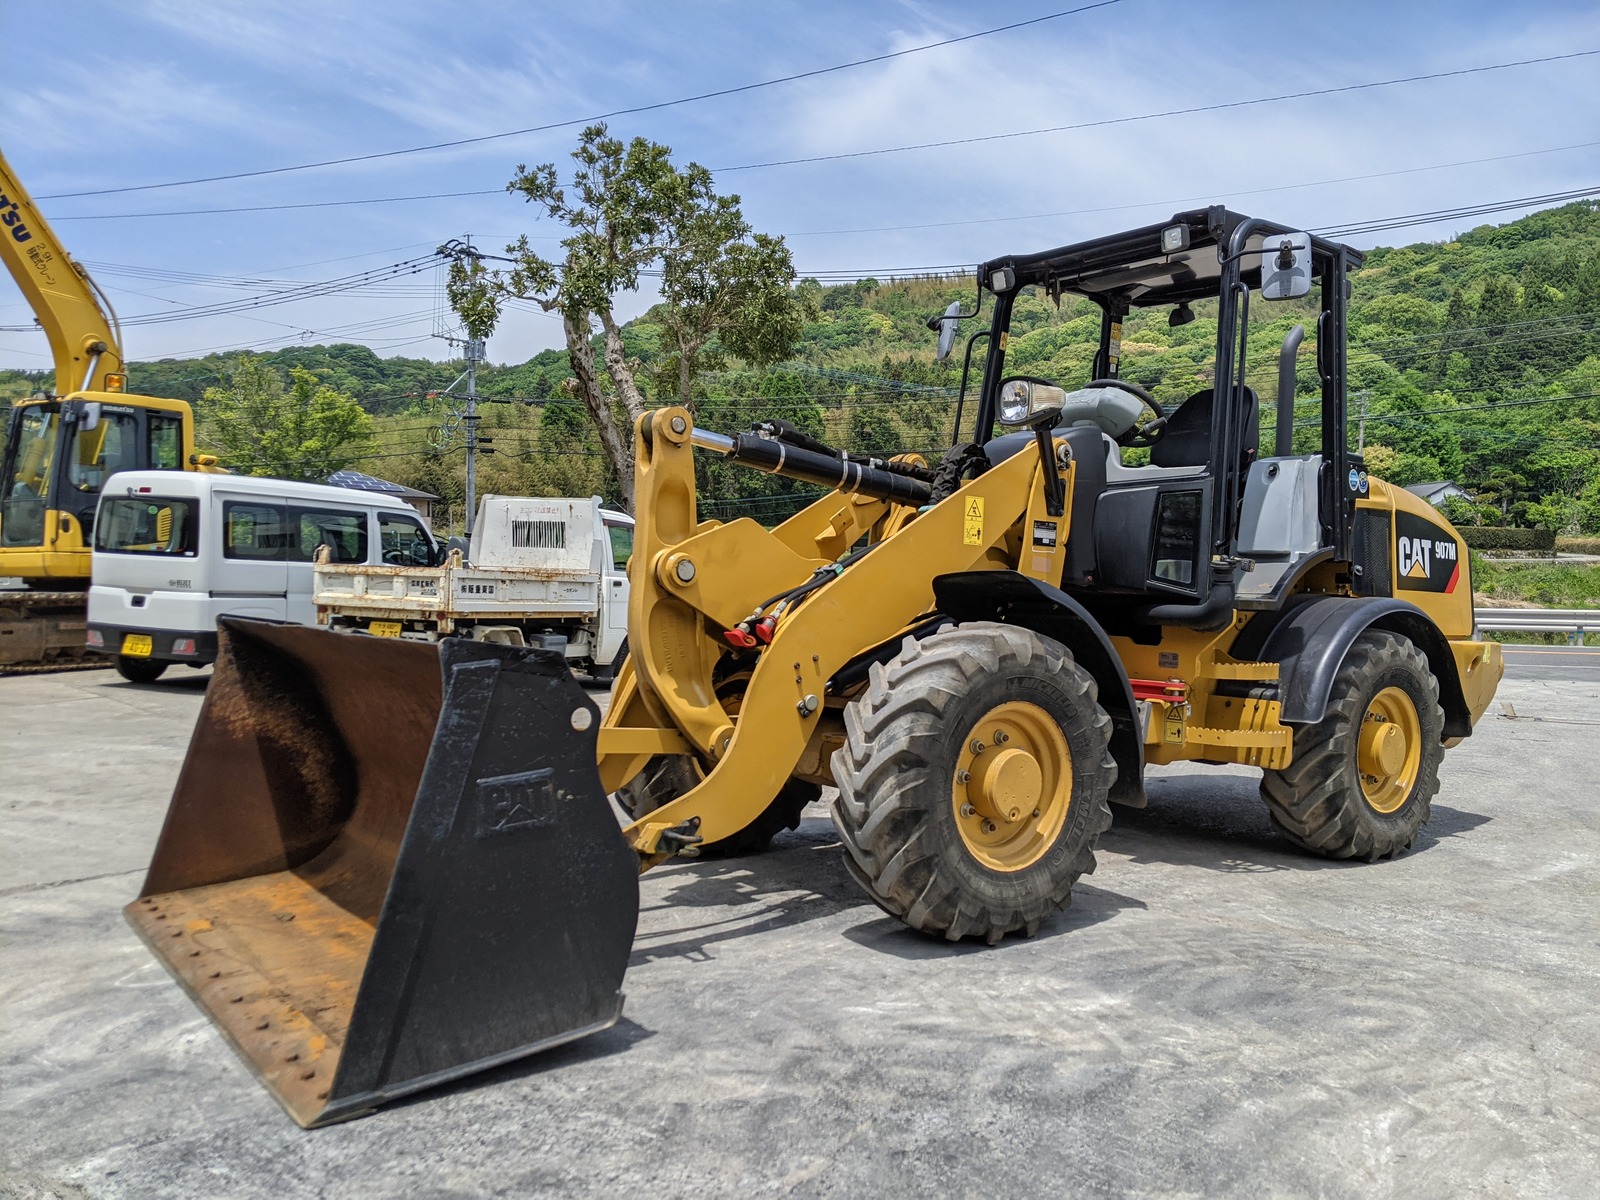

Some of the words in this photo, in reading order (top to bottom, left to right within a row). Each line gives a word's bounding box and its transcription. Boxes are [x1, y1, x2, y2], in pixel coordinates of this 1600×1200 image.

[0, 186, 32, 243] TSU
[26, 246, 56, 285] 移動式クレーン
[1399, 536, 1431, 578] CAT
[1435, 541, 1456, 560] 907M
